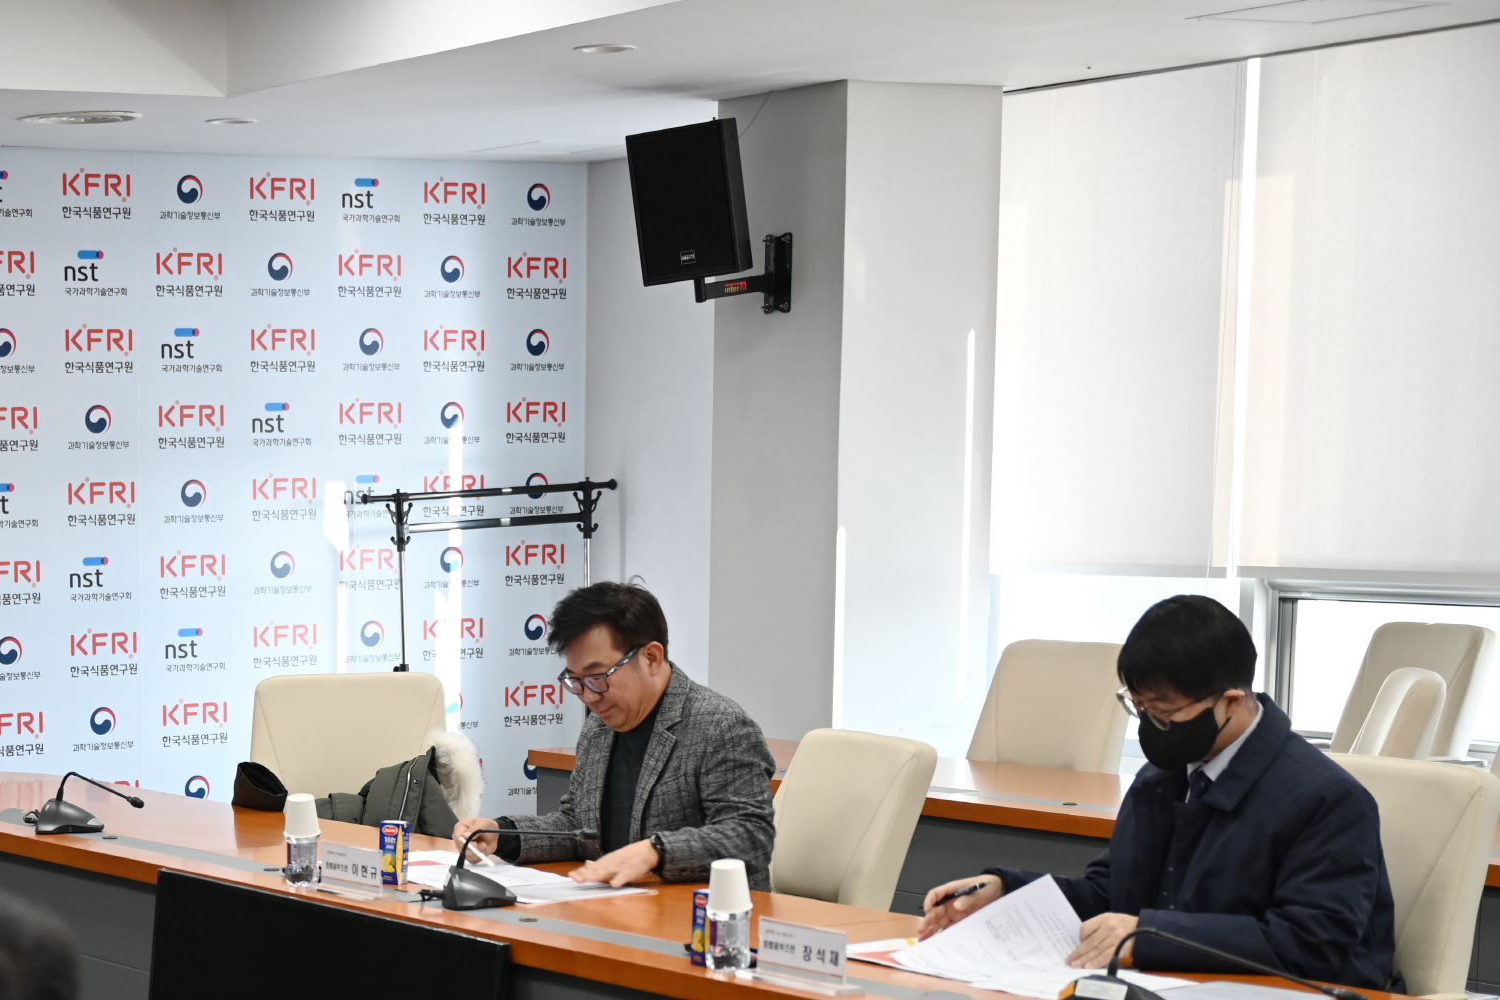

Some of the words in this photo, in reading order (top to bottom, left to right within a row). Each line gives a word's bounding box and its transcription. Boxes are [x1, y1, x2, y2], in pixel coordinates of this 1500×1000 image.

[63, 174, 131, 197] KFRI
[250, 178, 314, 200] KFRI
[62, 206, 131, 219] 한국식품연구원
[160, 211, 220, 220] 과학기술정보통신부
[249, 210, 314, 222] 한국식품연구원
[339, 255, 400, 276] KFRI
[156, 285, 222, 297] 한국식품연구원
[507, 288, 566, 299] 한국식품연구원
[66, 329, 133, 352] KFRI
[425, 330, 484, 351] KFRI
[65, 361, 133, 373] 한국식품연구원
[162, 364, 222, 373] 국가과학기술연구회
[343, 363, 399, 371] 과학기술정보통신부
[423, 361, 484, 372] 한국식품연구원
[159, 405, 224, 427] KFRI
[507, 402, 566, 423] KFRI
[339, 434, 401, 445] 한국식품연구원
[506, 432, 565, 443] 한국식품연구원
[68, 482, 135, 504] KFRI
[68, 514, 135, 526] 한국식품연구원
[506, 544, 564, 566] KFRI
[70, 569, 103, 588] nst
[71, 592, 131, 602] 국가과학기술연구회
[160, 586, 225, 599] 한국식품연구원
[71, 633, 136, 655] KFRI
[70, 663, 137, 677] 한국식품연구원
[164, 703, 226, 724] KFRI
[162, 733, 227, 747] 한국식품연구원
